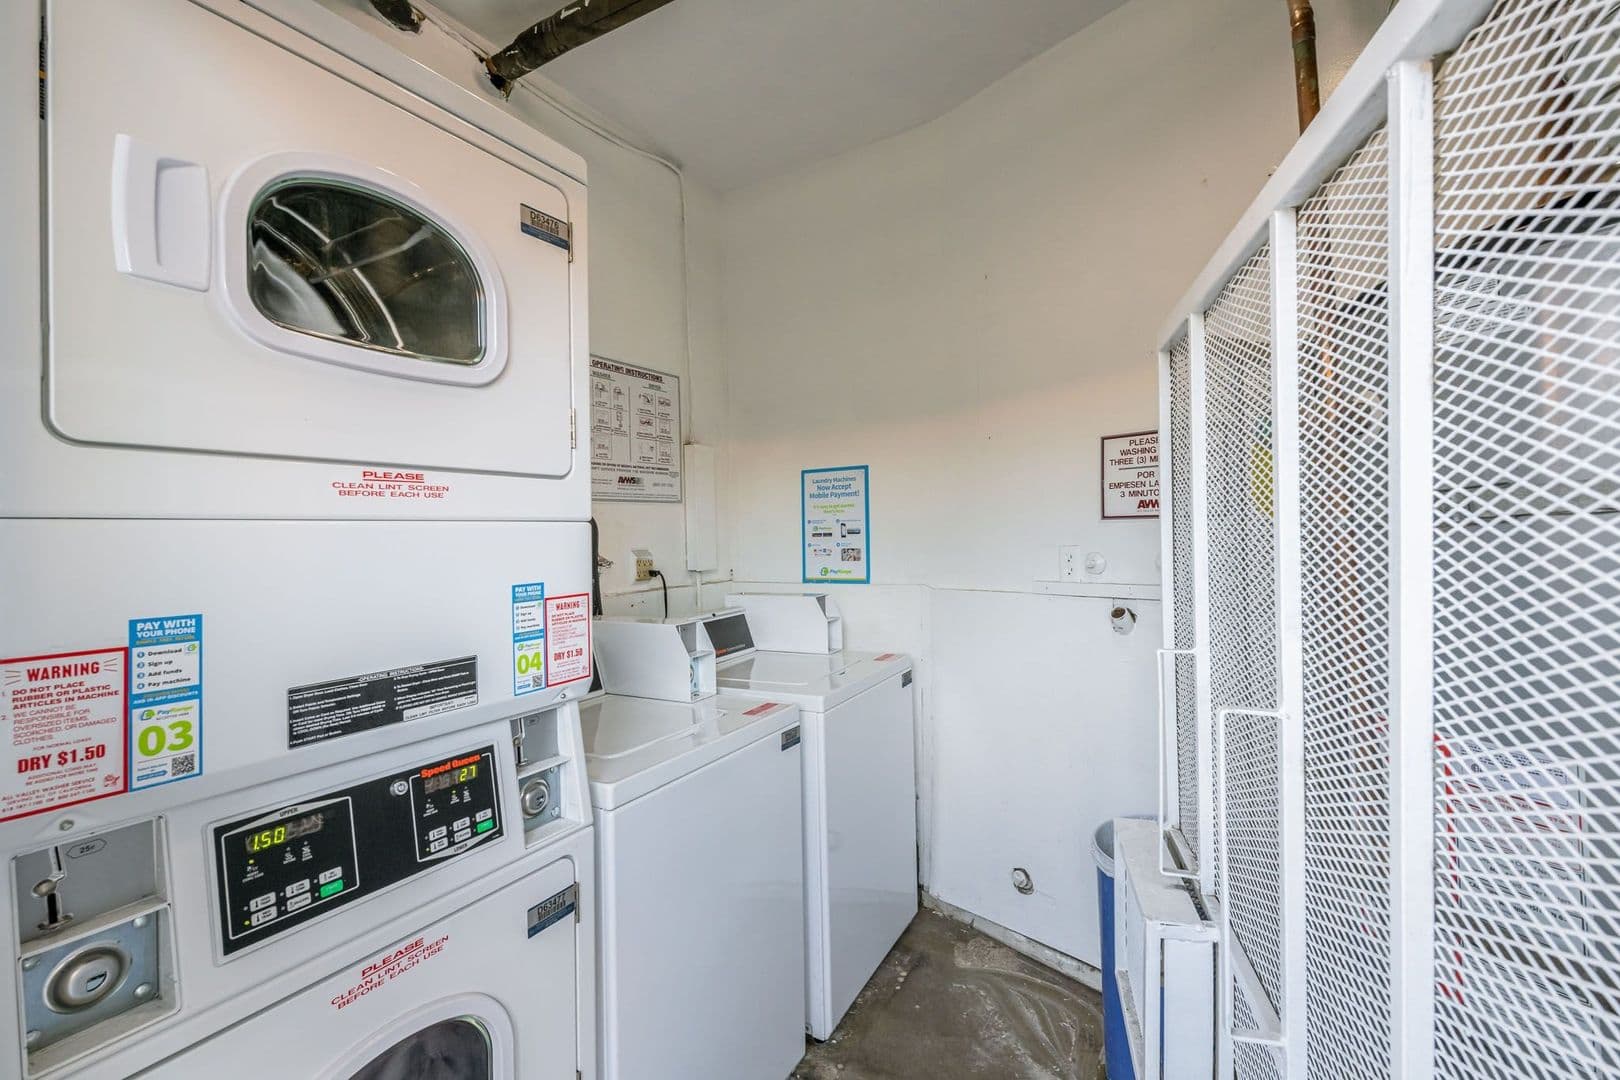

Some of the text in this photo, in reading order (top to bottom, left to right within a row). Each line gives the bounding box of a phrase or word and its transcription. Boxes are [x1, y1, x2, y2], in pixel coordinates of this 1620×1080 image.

[592, 360, 663, 383] OPERATING INSTRUCTIONS
[1120, 446, 1157, 456] WASHING
[1109, 457, 1134, 466] THREE
[1137, 456, 1147, 465] (3)
[363, 470, 424, 480] PLEASE
[812, 475, 856, 485] Laundry Machines
[1137, 471, 1155, 479] POR
[332, 481, 374, 489] CLEAN
[817, 482, 852, 492] Now Accept
[1109, 481, 1146, 490] EMPIESEN
[338, 489, 385, 497] BEFORE
[809, 489, 860, 499] Mobile Payment!
[555, 601, 580, 611] WARNING
[137, 618, 196, 631] PAY WITH
[136, 627, 196, 639] YOUR PHONE
[148, 648, 182, 656] Download
[553, 648, 583, 662] DRY $1.50
[148, 661, 164, 669] Sign
[517, 651, 542, 675] 04
[27, 661, 100, 682] WARNING
[12, 688, 28, 697] DO
[29, 685, 51, 694] NOT
[53, 681, 85, 691] PLACE
[148, 677, 191, 690] Pay machine
[12, 684, 111, 704] RUBBER OR PLASTIC
[12, 690, 120, 710] ARTICLES IN MACHINE
[13, 708, 90, 725] RESPONSIBLE FOR
[14, 711, 24, 719] WE
[26, 706, 62, 718] CANNOT
[13, 720, 61, 733] OVERSIZED
[65, 723, 77, 731] OR
[78, 717, 117, 729] DAMAGED
[138, 720, 194, 757] 03
[17, 744, 106, 774] DRY $1.50
[420, 753, 481, 778] Speed Queen
[459, 765, 477, 782] 27
[42, 782, 70, 793] WASHER
[71, 777, 95, 786] SERVICE
[279, 807, 299, 818] UPPER
[362, 938, 424, 977] PLEASE
[331, 935, 449, 1005] CLEAN LINT SCREEN
[337, 945, 445, 1009] BEFORE EACH USE
